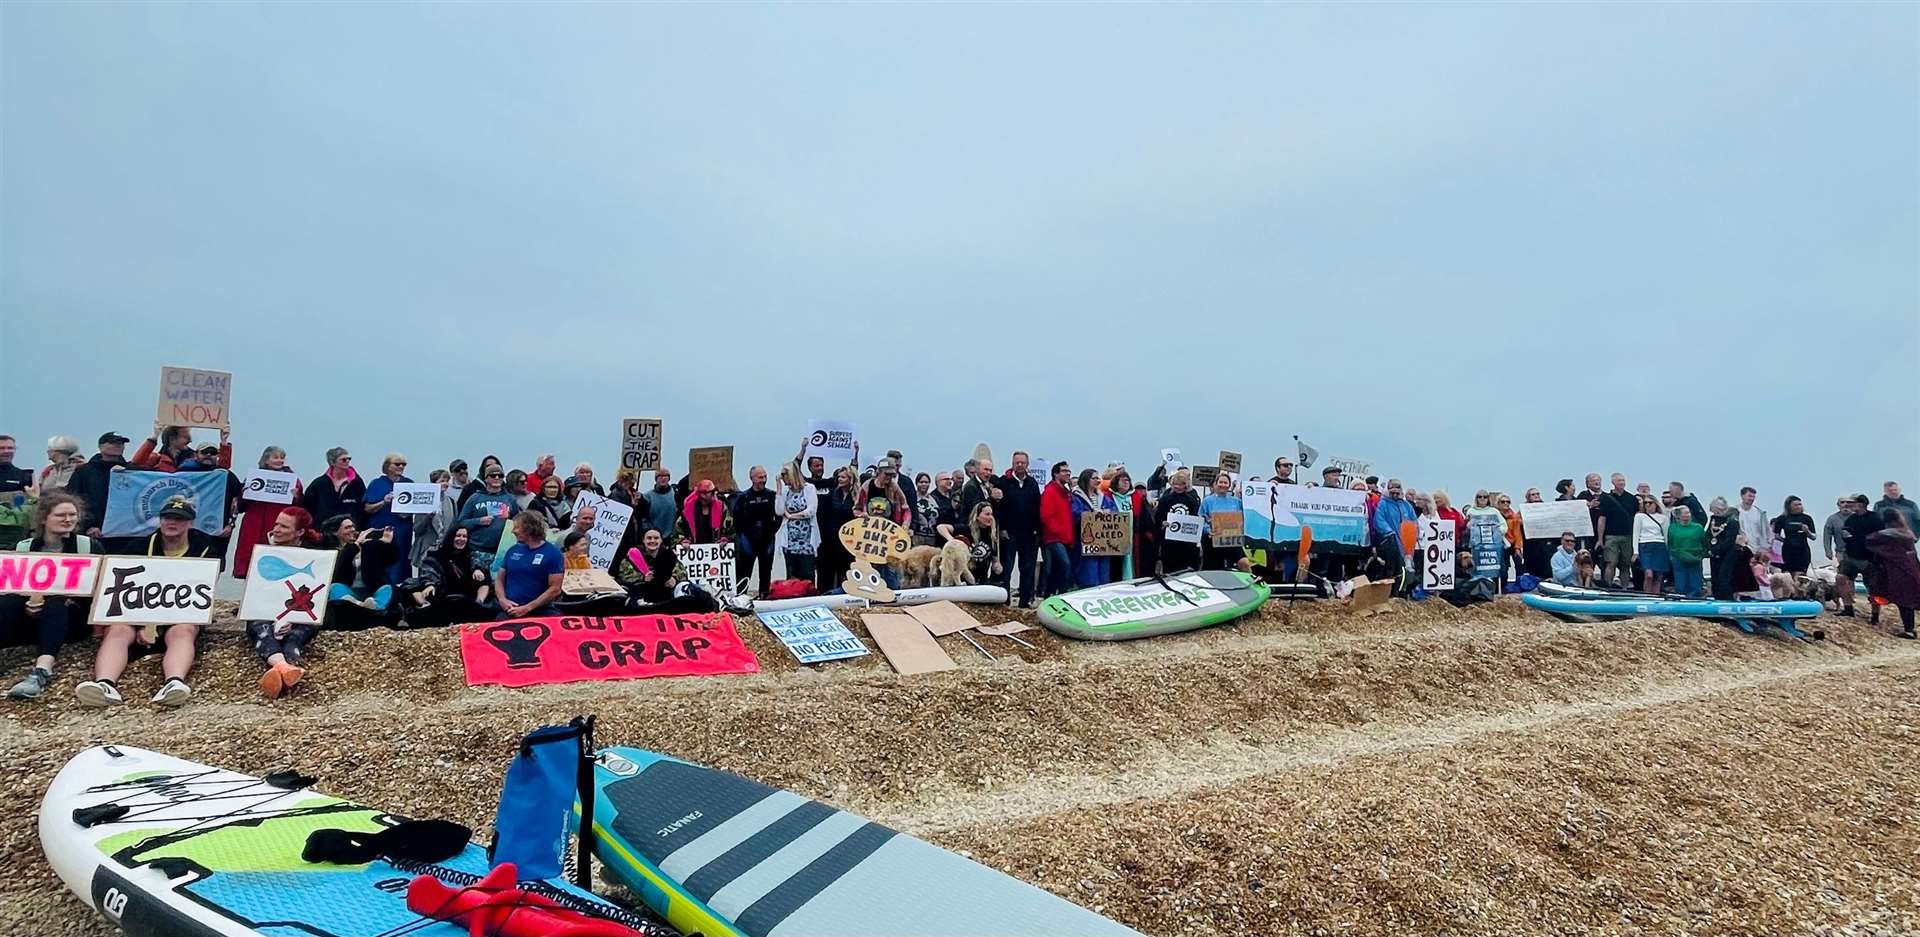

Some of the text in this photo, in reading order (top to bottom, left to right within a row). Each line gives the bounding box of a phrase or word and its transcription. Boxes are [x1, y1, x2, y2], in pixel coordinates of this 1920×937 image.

[167, 370, 225, 390] CLEAN
[165, 388, 224, 405] WATER
[173, 404, 222, 423] NOW
[628, 423, 659, 438] CUT
[630, 441, 652, 451] THE
[623, 451, 658, 469] CRAP
[600, 509, 628, 525] more
[861, 516, 897, 535] SAVE
[1095, 512, 1128, 522] PROFIT
[1427, 522, 1454, 541] Save
[591, 538, 613, 549] our
[1427, 544, 1454, 563] Our
[0, 558, 91, 591] NOT
[687, 561, 732, 578] EEP IT
[1426, 565, 1453, 588] Sea
[104, 565, 212, 618] Faeces
[1082, 587, 1210, 619] GREENPEACE
[560, 617, 625, 633] CUT
[770, 613, 791, 626] NO
[577, 637, 712, 670] CRAP
[791, 643, 815, 656] NO
[656, 810, 704, 838] FANATIC
